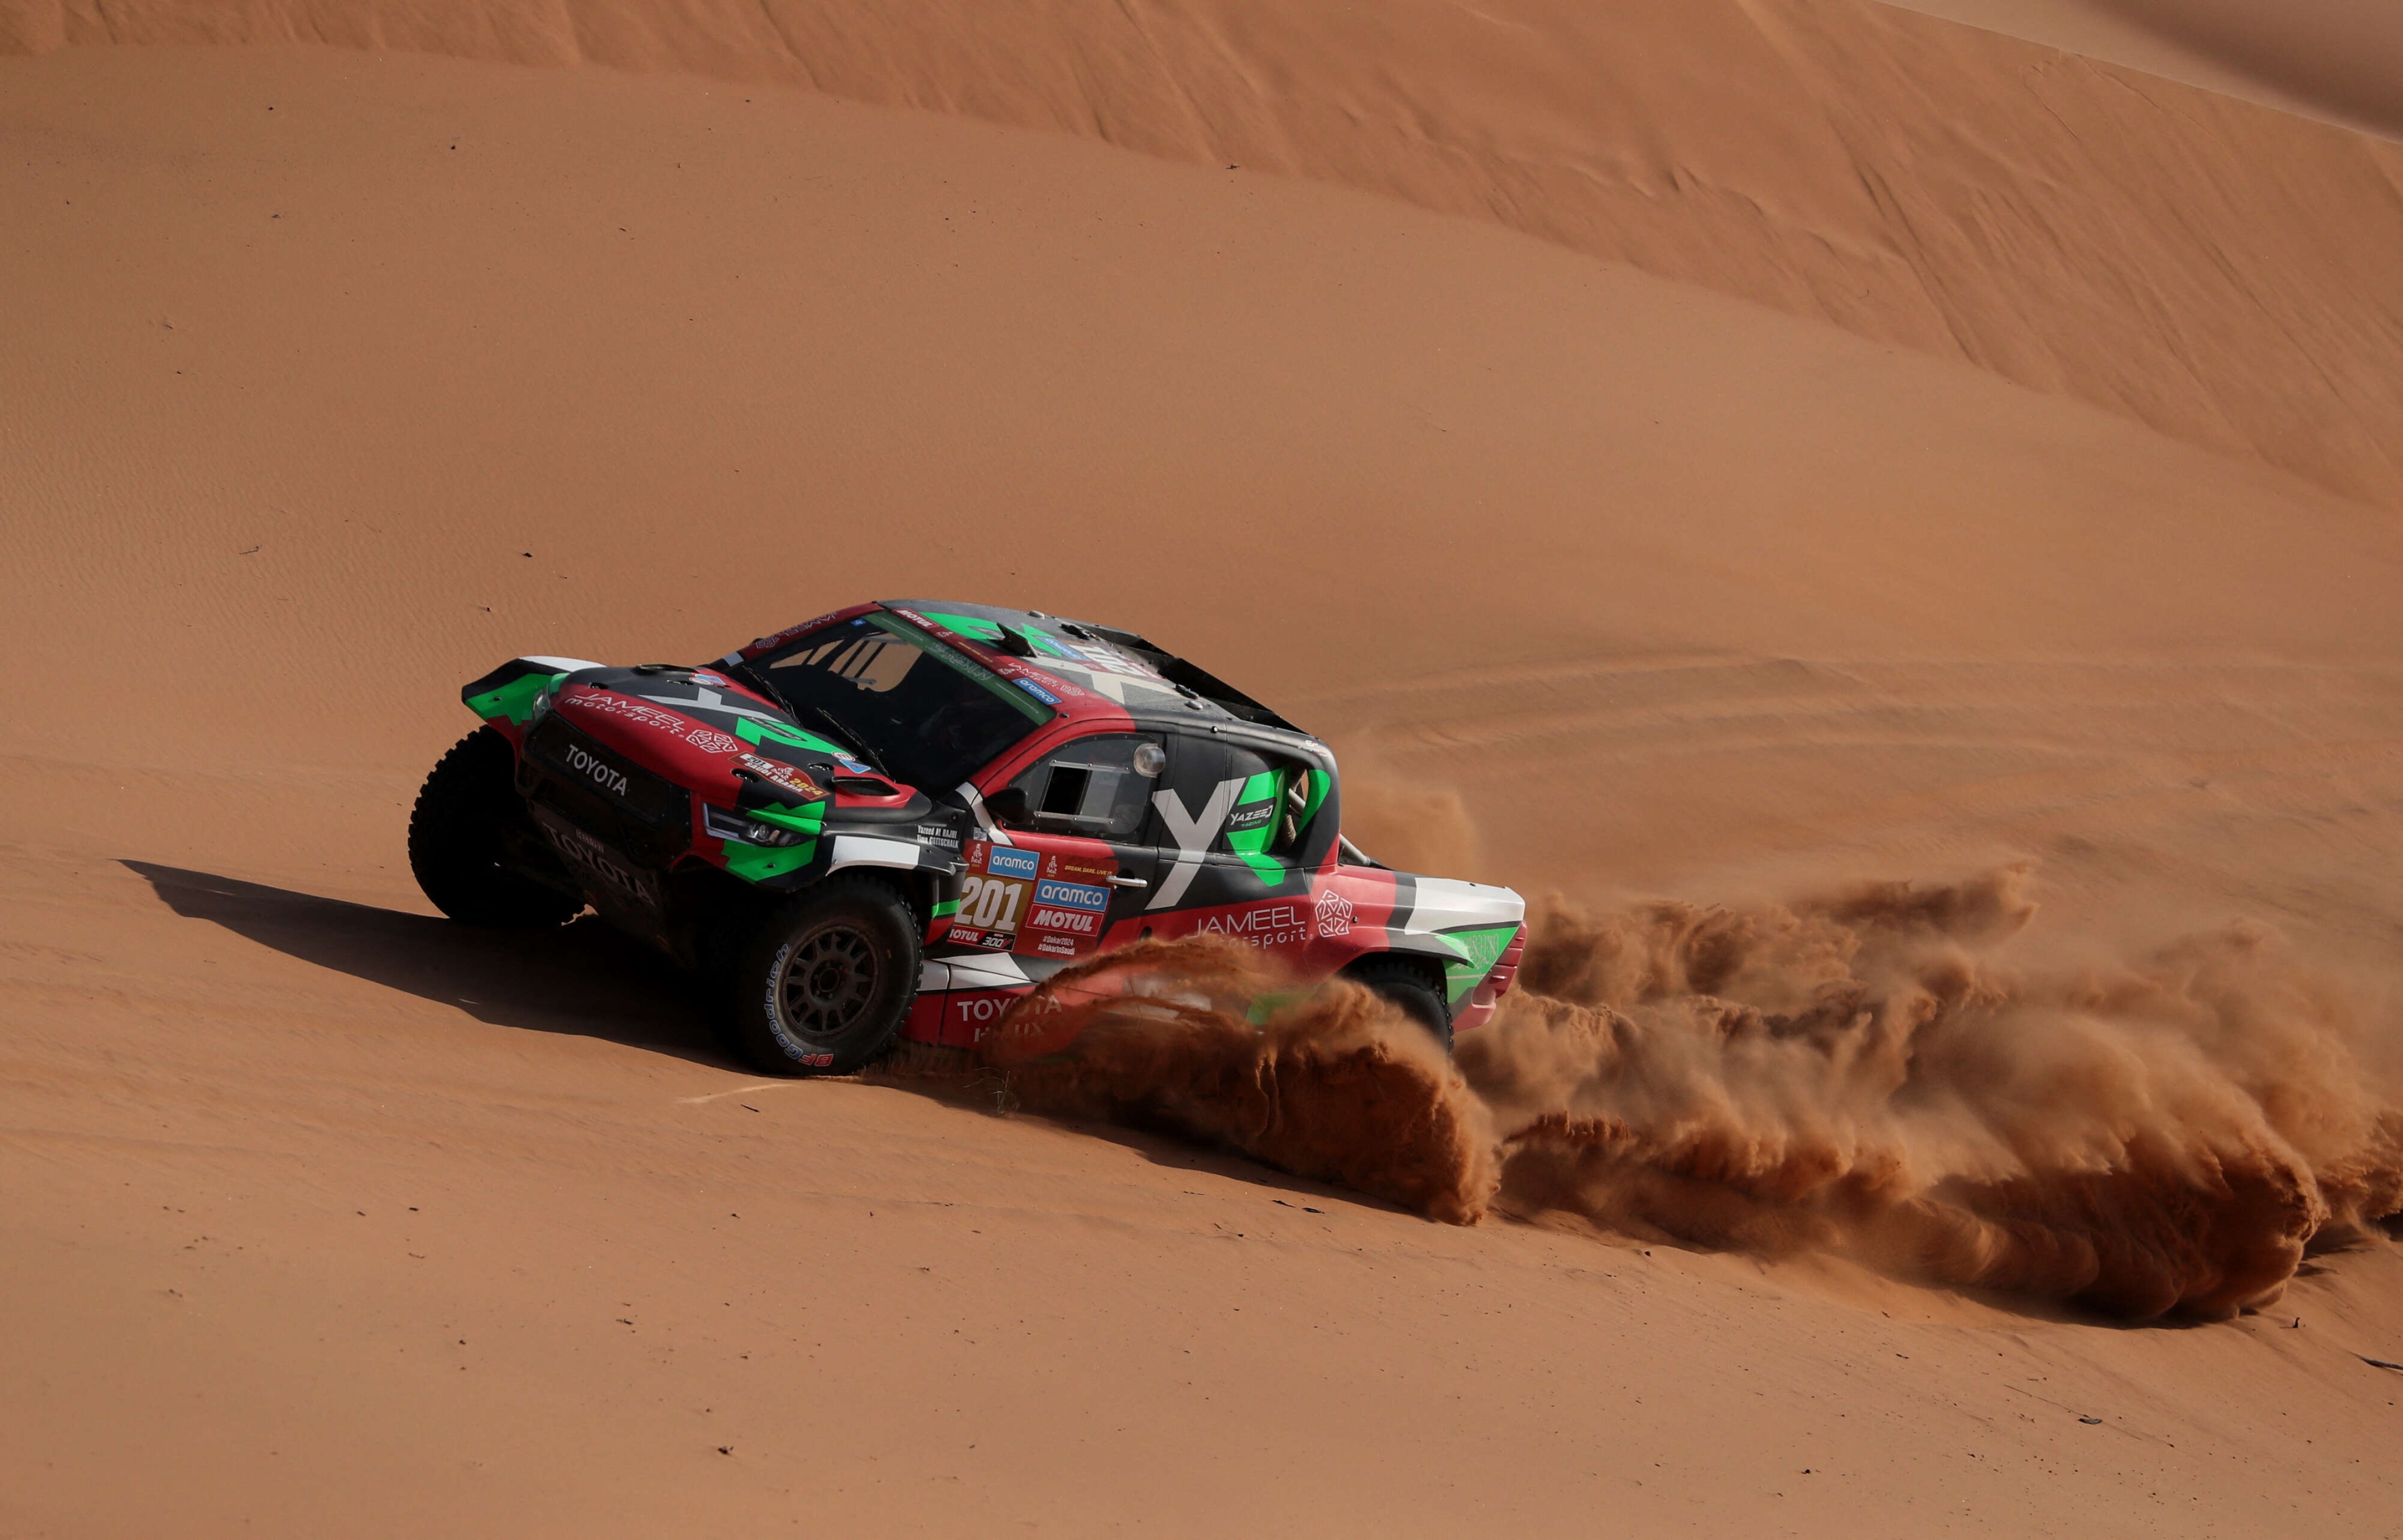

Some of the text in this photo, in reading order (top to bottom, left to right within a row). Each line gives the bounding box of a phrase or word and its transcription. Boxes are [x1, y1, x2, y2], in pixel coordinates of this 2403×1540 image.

[897, 609, 933, 627] MOTUL
[1020, 680, 1055, 703] aramco
[565, 698, 679, 735] motorsport
[575, 693, 685, 731] JAMEEL
[565, 743, 628, 797] TOYOTA
[747, 756, 767, 769] 201
[744, 762, 803, 792] SAUDI ARABIA
[789, 777, 824, 796] 2024
[918, 824, 935, 836] Yazeed
[541, 821, 657, 907] TOYOTA
[992, 855, 1035, 871] aramco
[954, 876, 1023, 932] 201
[1041, 884, 1104, 906] aramco
[1032, 909, 1094, 933] MOTUL
[1187, 906, 1306, 939] JAMEEL
[1042, 935, 1075, 946] #Dakar2024
[764, 943, 835, 1067] BFGoodrich
